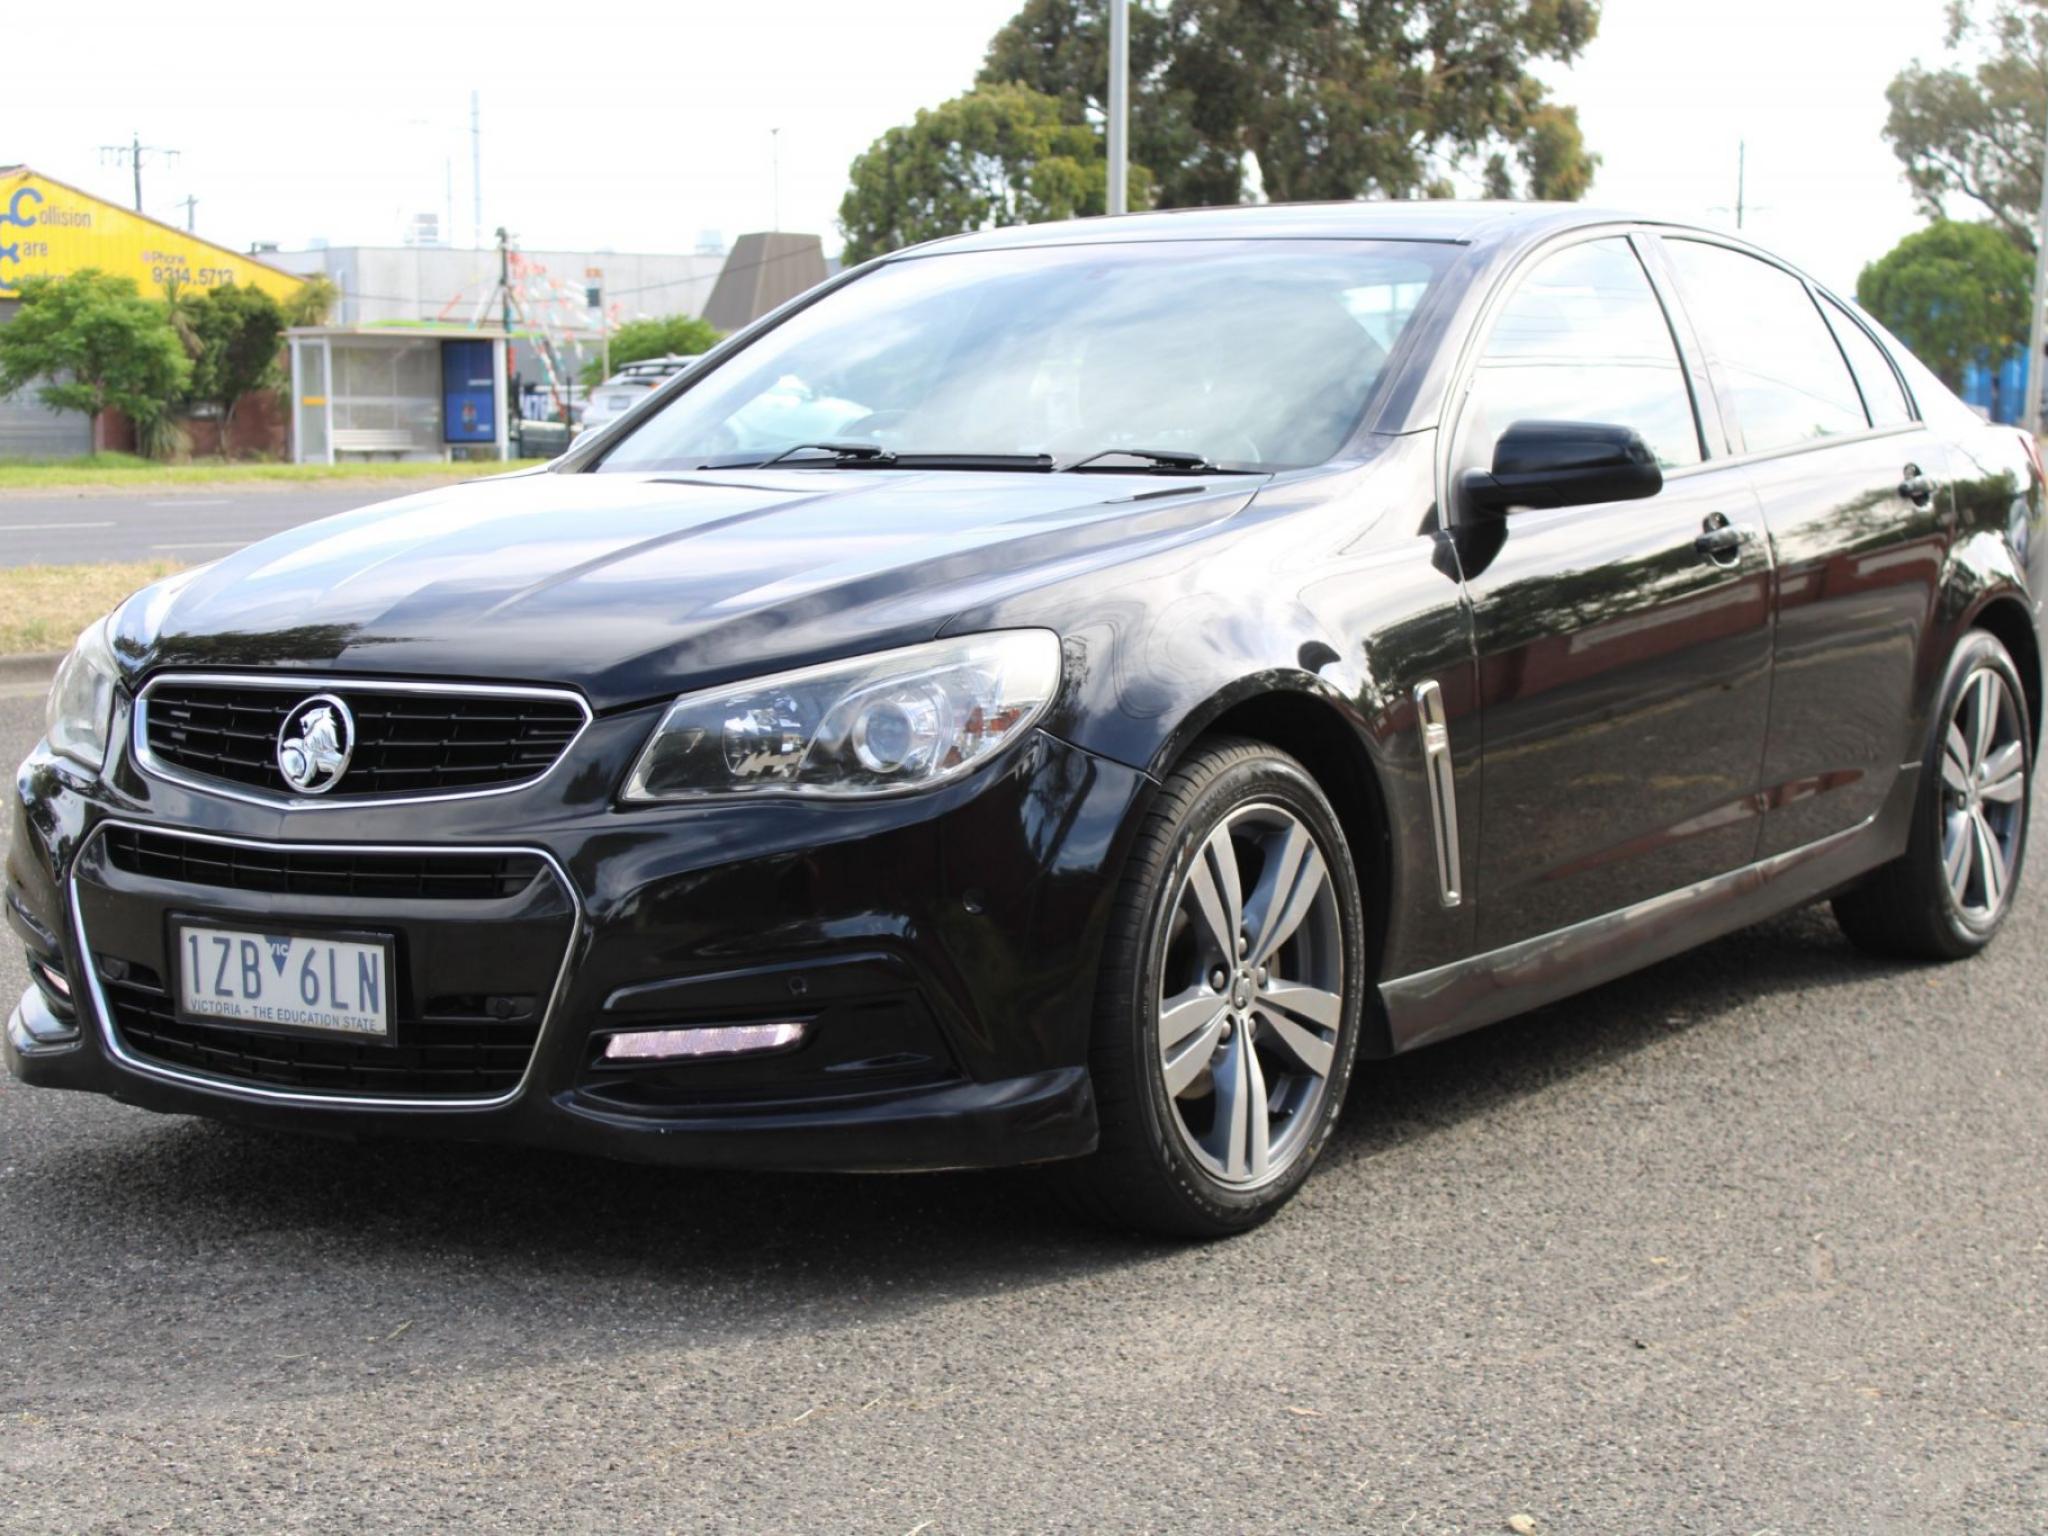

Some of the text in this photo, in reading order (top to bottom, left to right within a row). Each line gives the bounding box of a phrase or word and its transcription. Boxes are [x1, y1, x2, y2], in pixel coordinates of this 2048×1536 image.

[10, 187, 91, 228] Collision
[300, 947, 379, 1014] 6LN
[191, 999, 241, 1016] VICTORIA
[252, 1005, 273, 1020] THE
[277, 1008, 340, 1027] EDUCATION
[343, 1017, 377, 1033] STATE
